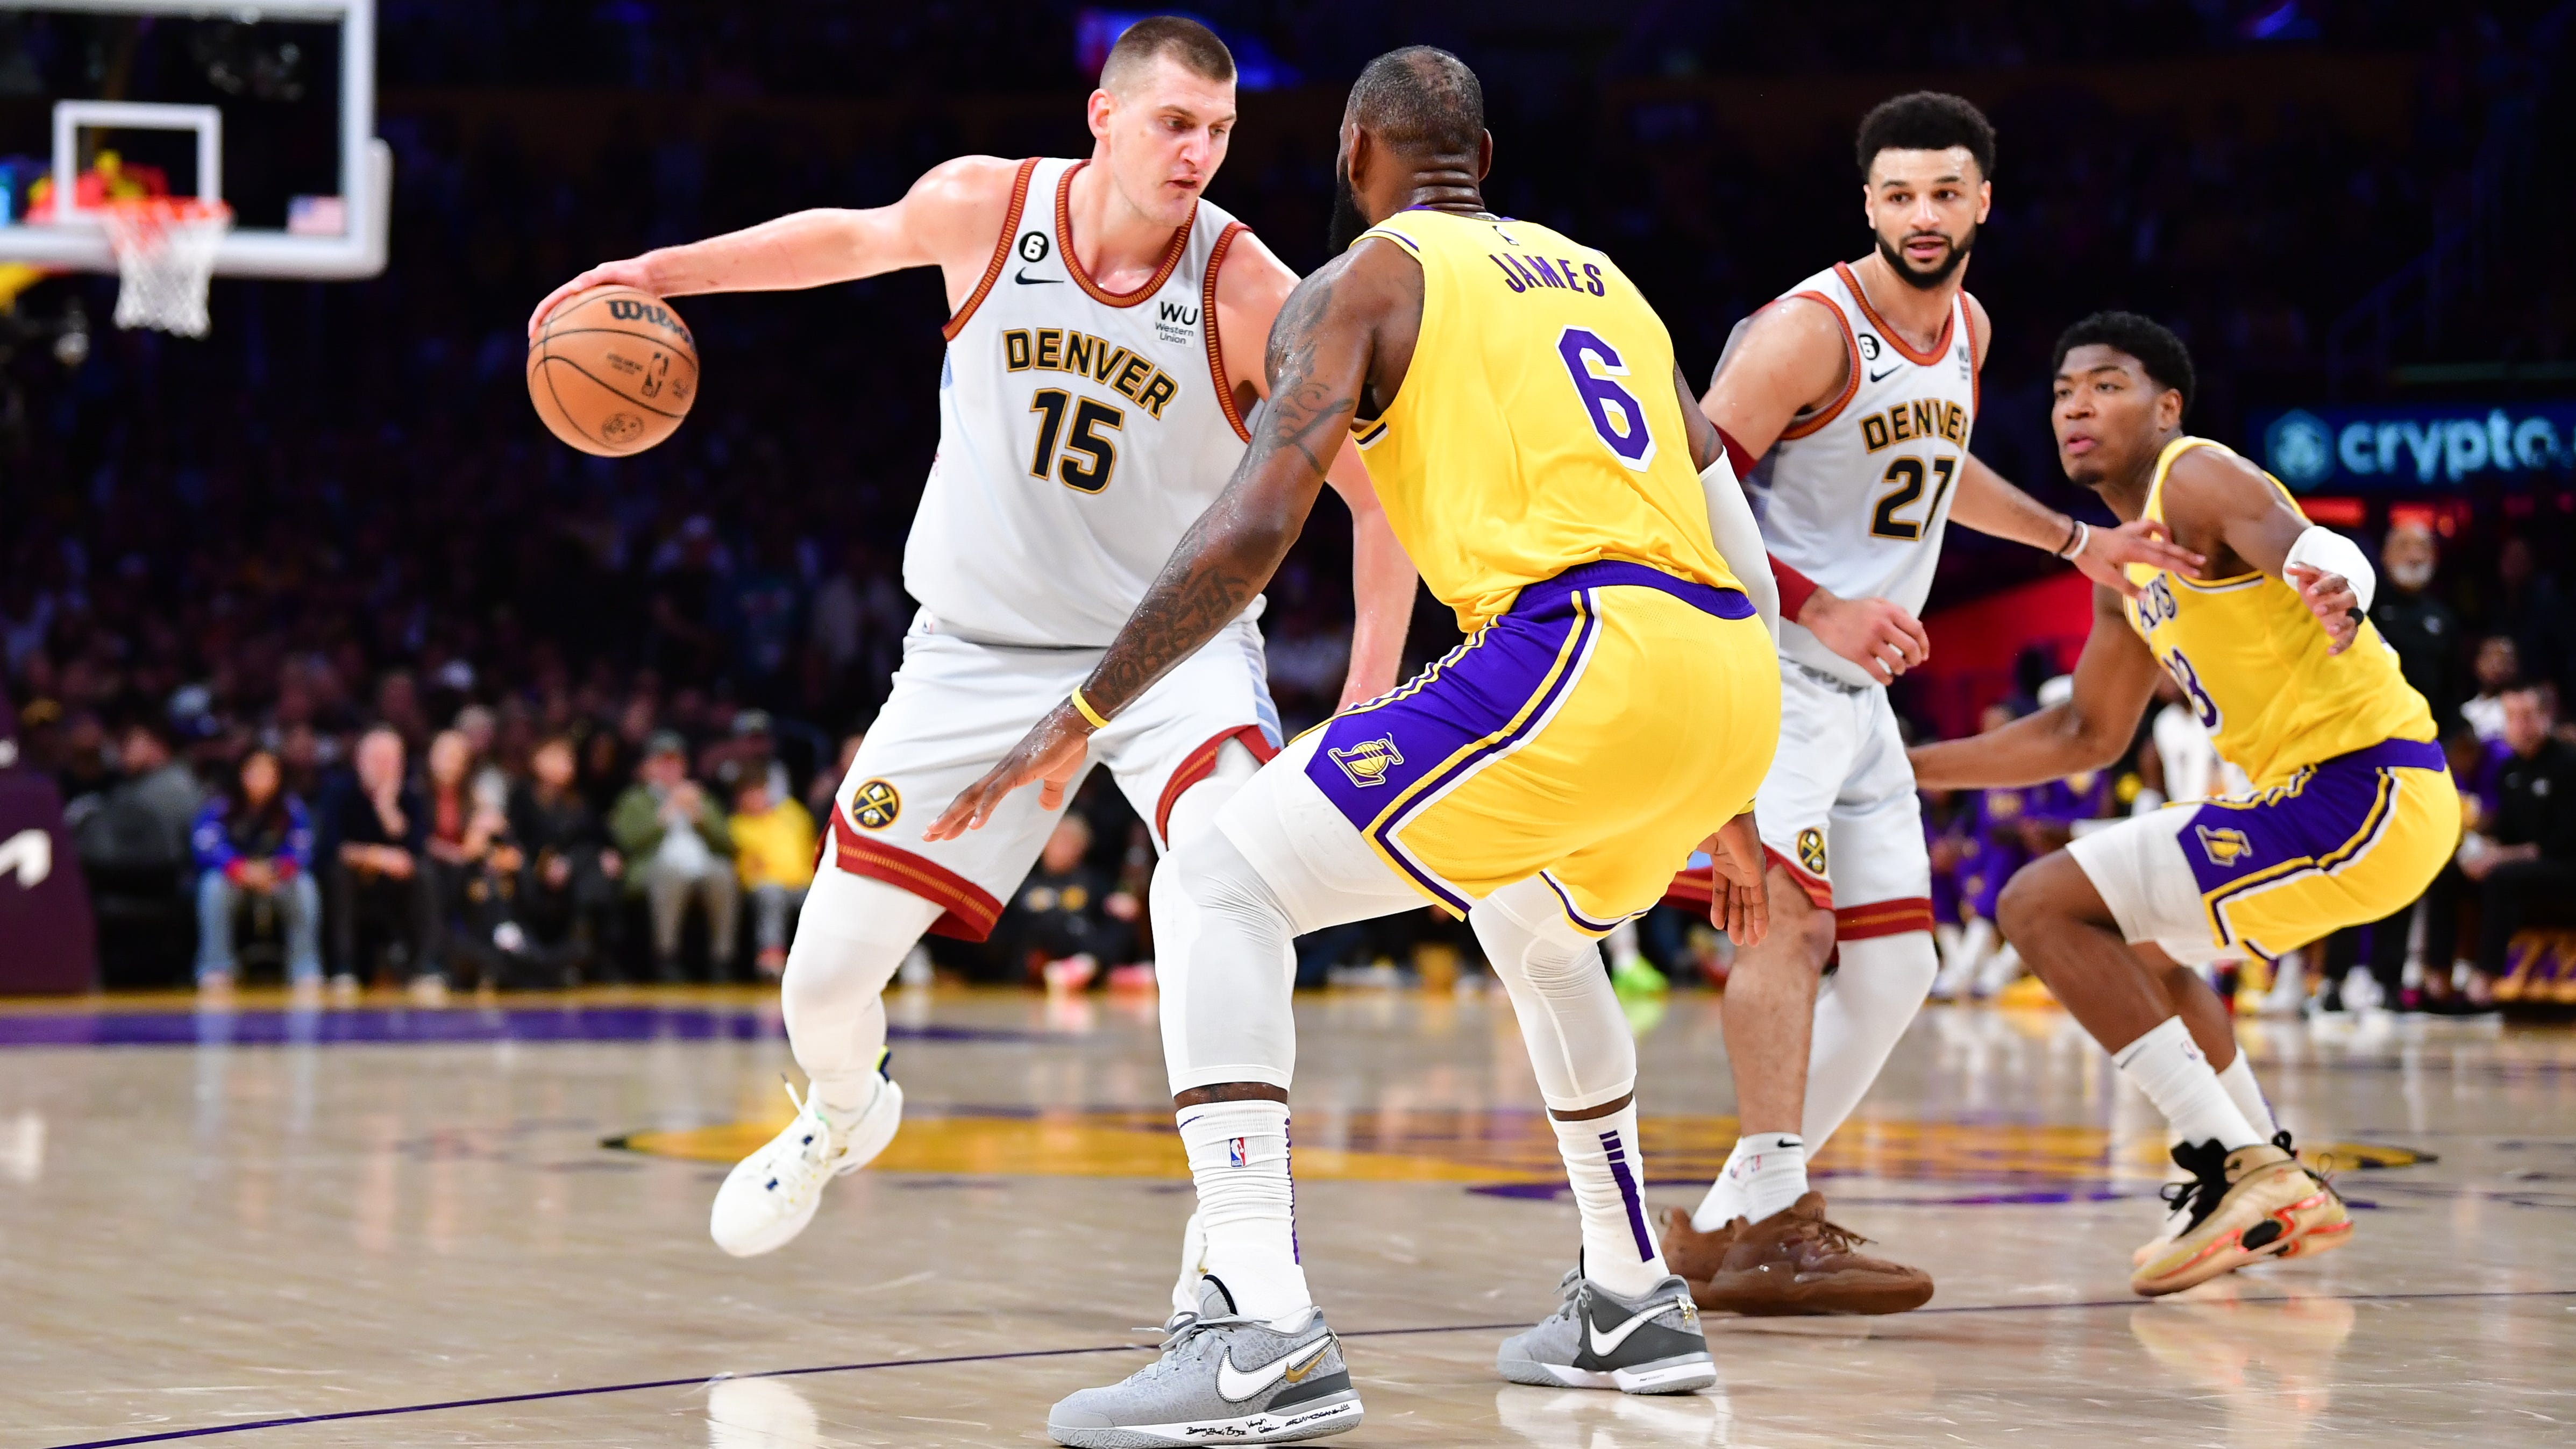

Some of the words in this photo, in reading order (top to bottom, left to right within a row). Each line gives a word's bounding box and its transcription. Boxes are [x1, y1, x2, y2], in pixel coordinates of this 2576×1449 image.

[1023, 234, 1045, 260] 6
[1488, 253, 1605, 297] JAMES
[1155, 322, 1194, 337] Western
[1160, 301, 1199, 325] WU
[1159, 332, 1186, 344] Union
[1861, 337, 1876, 359] 6
[1002, 328, 1178, 421] DENVER
[1555, 324, 1657, 473] 6
[1029, 387, 1125, 494] 15
[1869, 455, 1956, 541] 27
